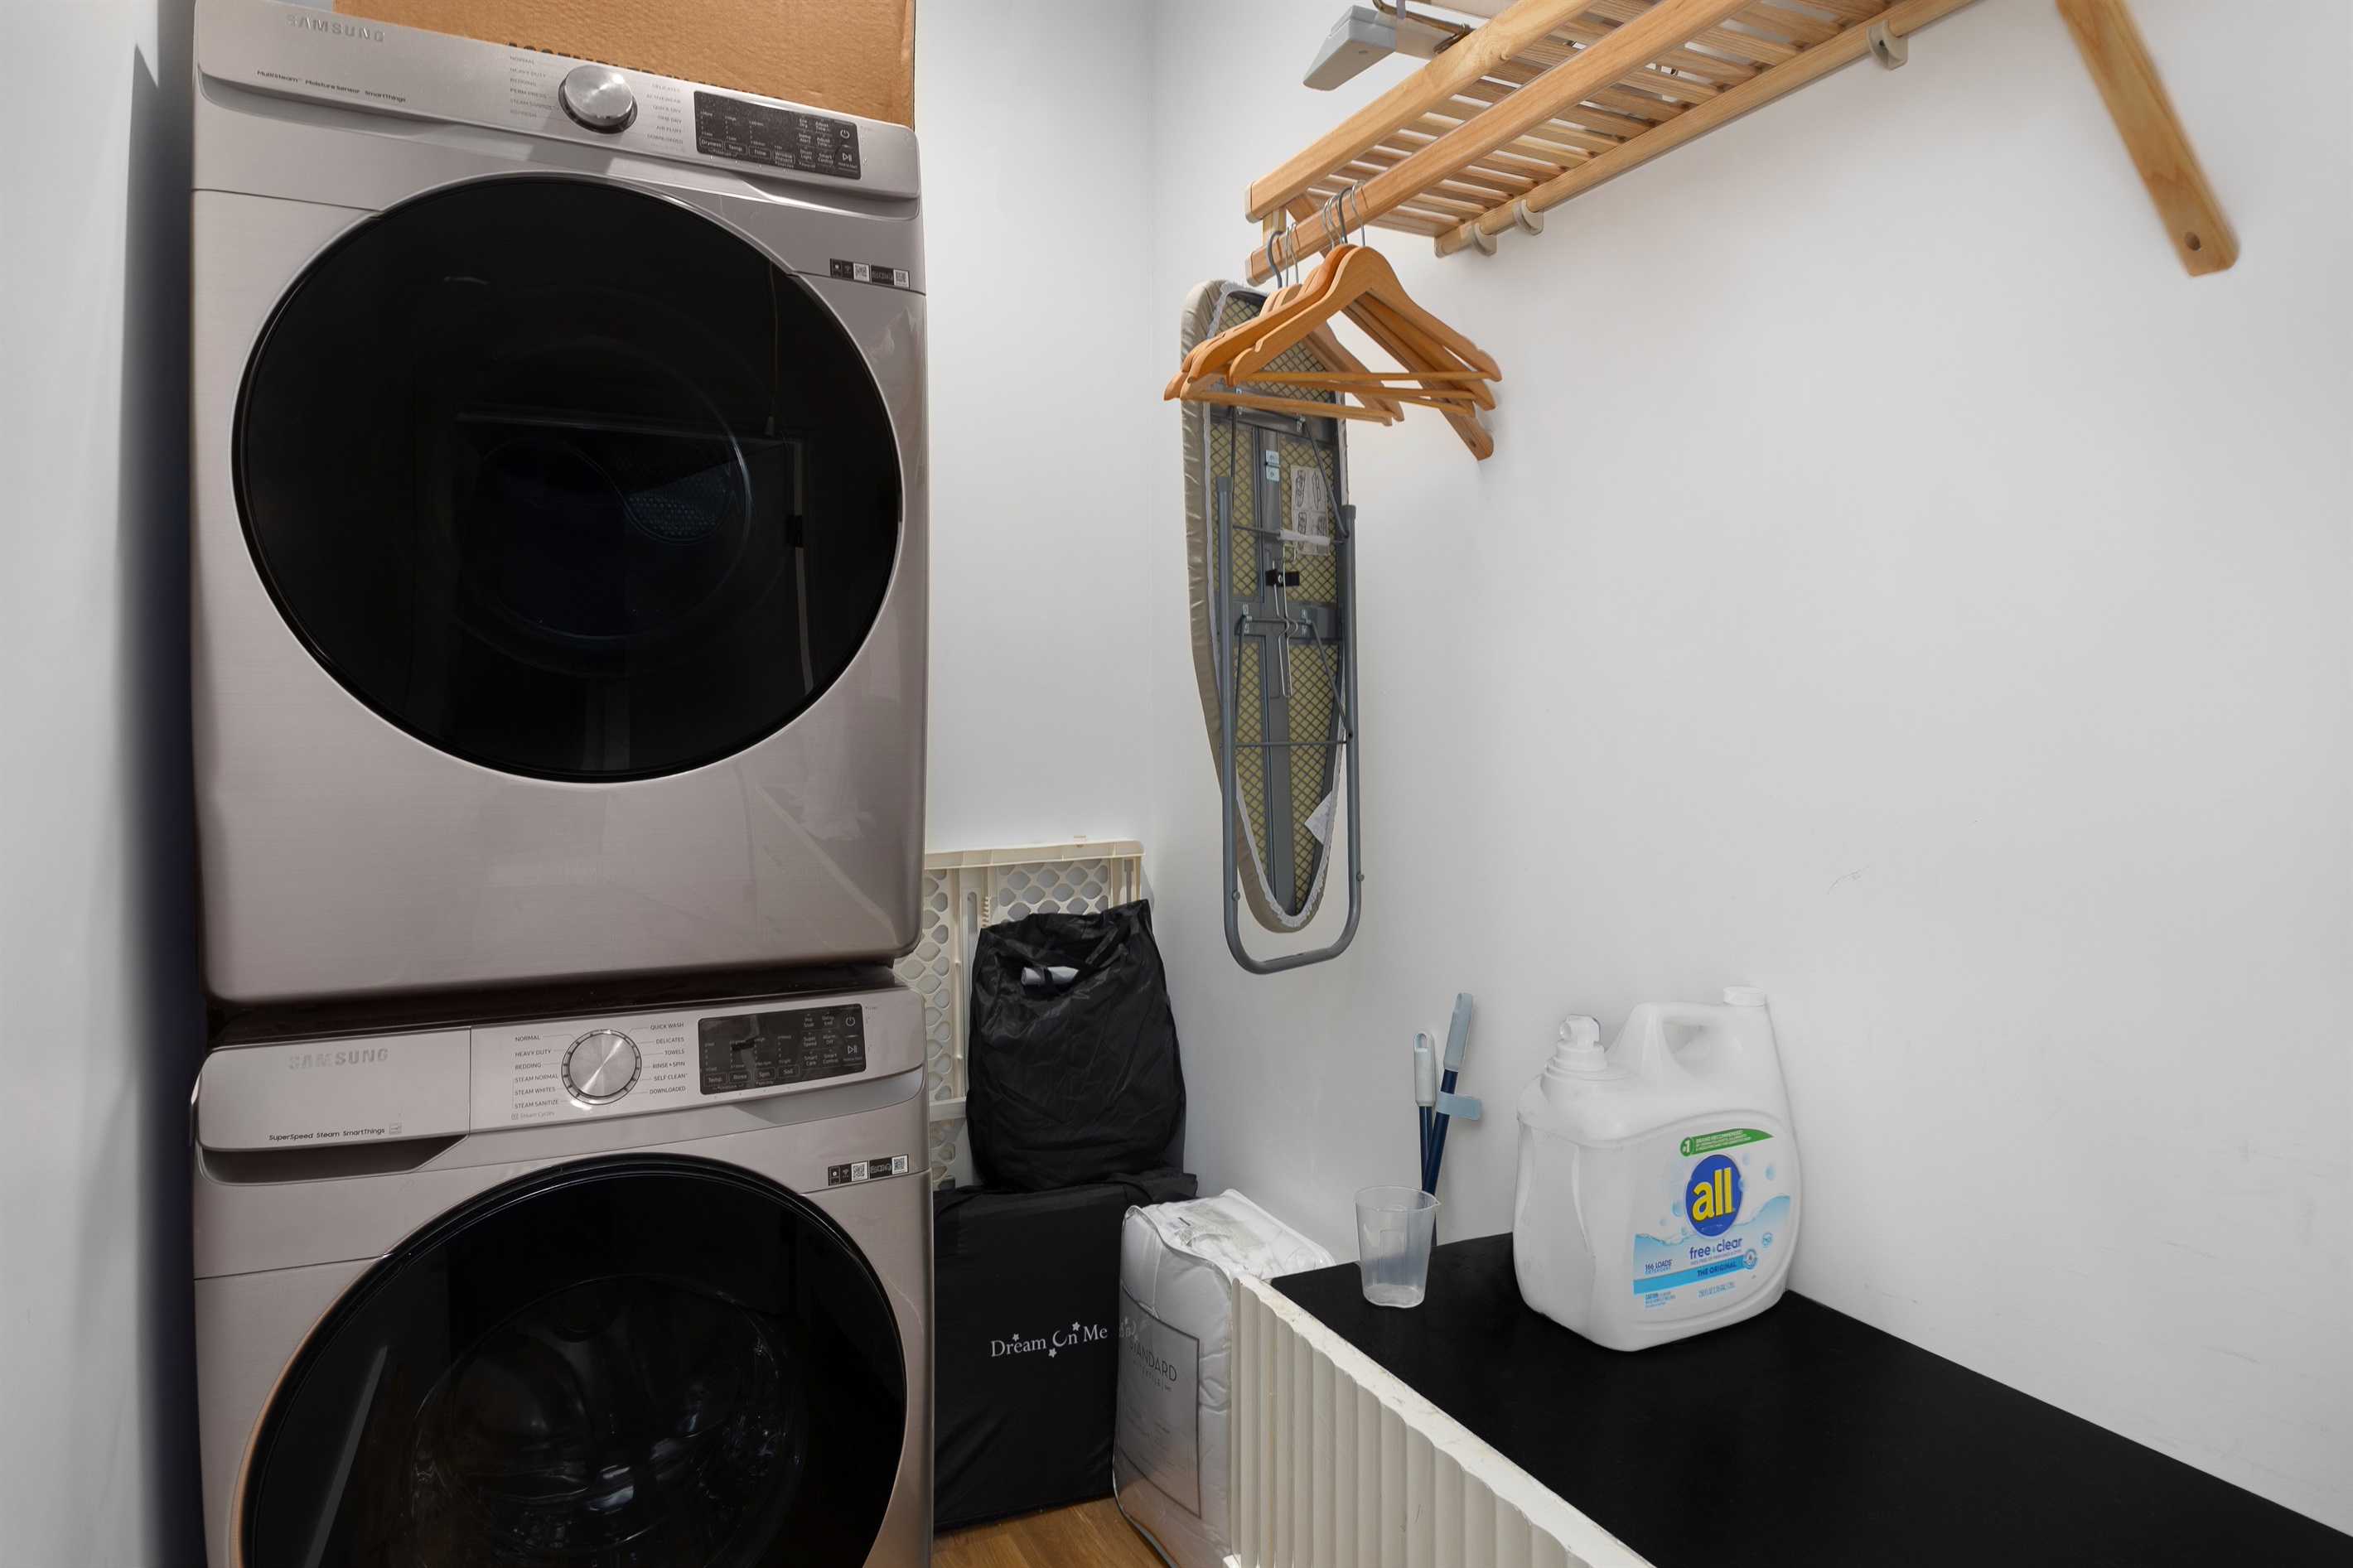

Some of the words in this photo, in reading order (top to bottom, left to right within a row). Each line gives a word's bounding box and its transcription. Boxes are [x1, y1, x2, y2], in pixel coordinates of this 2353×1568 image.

[286, 13, 385, 42] SAMSUNG
[305, 80, 336, 90] Moisture
[336, 85, 360, 94] Sensor
[365, 90, 406, 103] SmartThings
[652, 84, 680, 93] DELICATES
[646, 94, 681, 104] ACTIVEWEAR
[647, 133, 684, 144] DOWNLOADED
[701, 139, 722, 147] Dryness
[288, 1049, 389, 1070] SAMSUNG
[650, 1086, 686, 1094] DOWNLOADED
[268, 1133, 313, 1142] SuperSpeed
[342, 1128, 385, 1136] SmartThings
[1682, 1141, 1690, 1153] #1
[1692, 1166, 1734, 1222] all
[1689, 1246, 1711, 1260] free
[1716, 1238, 1743, 1252] clear
[1645, 1266, 1671, 1276] DETERGENT
[1698, 1267, 1708, 1277] THE
[1709, 1261, 1737, 1274] ORIGINAL
[991, 1339, 1047, 1357] Dream
[1052, 1329, 1078, 1348] On
[1083, 1324, 1108, 1343] Me
[1128, 1334, 1177, 1382] STANDARD
[1139, 1363, 1161, 1387] TEXTILE
